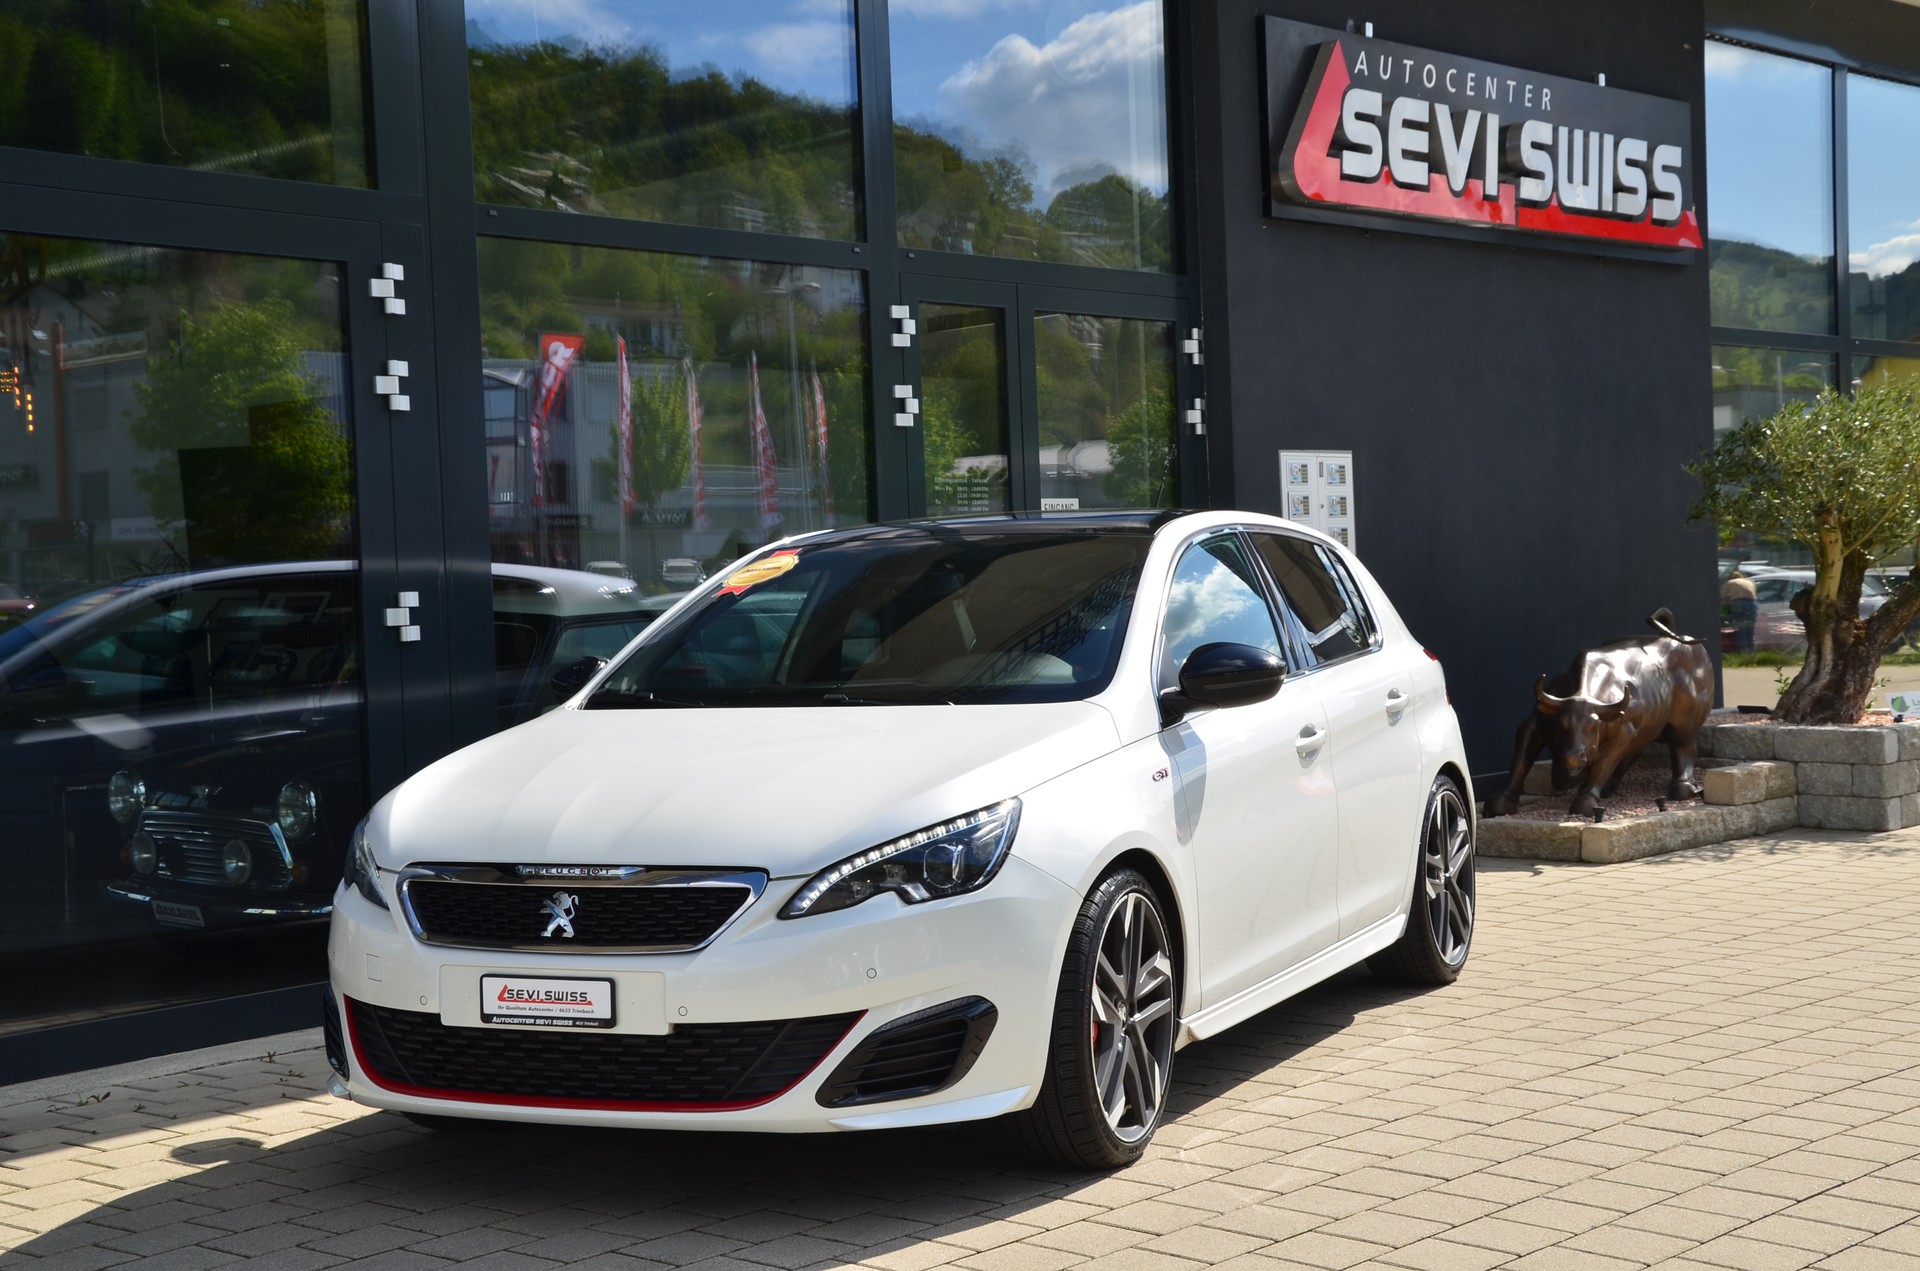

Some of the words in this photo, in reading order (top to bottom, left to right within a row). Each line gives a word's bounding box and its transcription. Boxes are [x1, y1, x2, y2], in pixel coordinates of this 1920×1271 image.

[1354, 50, 1552, 111] AUTOCENTER
[1340, 87, 1500, 197] SEVI
[1519, 118, 1683, 222] SWISS
[533, 867, 612, 877] PEUGEOT
[506, 988, 541, 1001] SEVI
[544, 990, 589, 1003] SWISS
